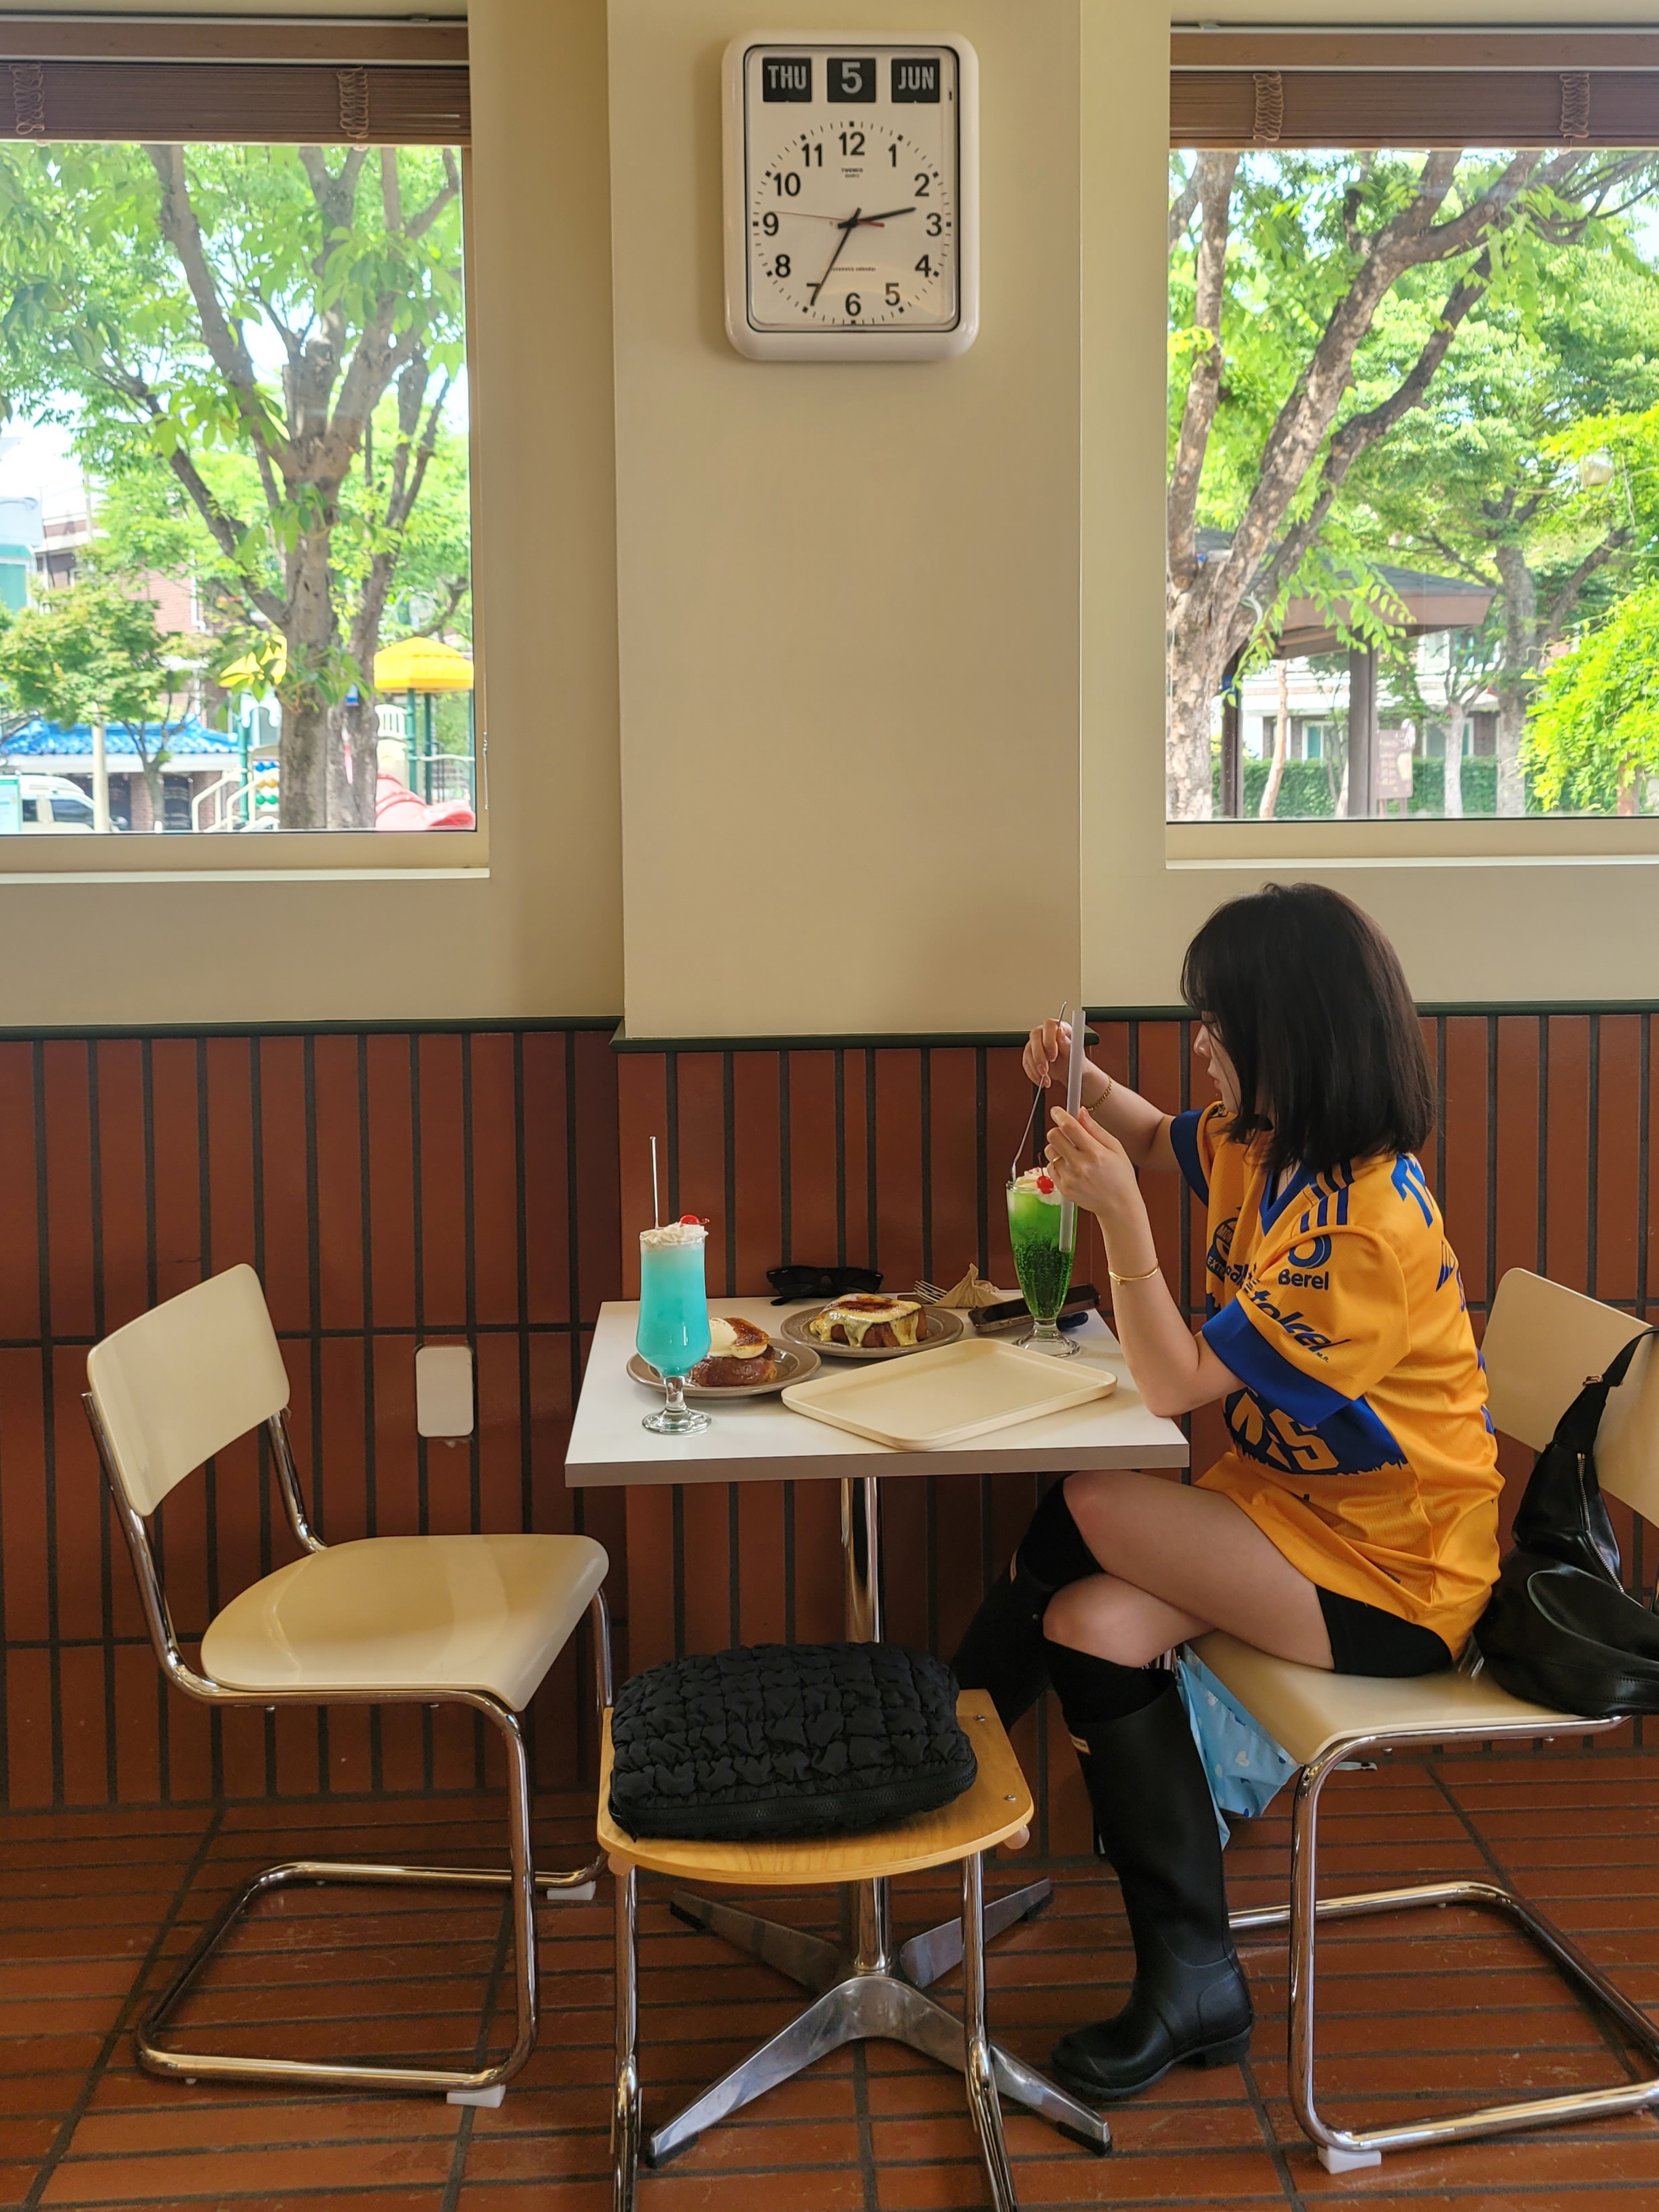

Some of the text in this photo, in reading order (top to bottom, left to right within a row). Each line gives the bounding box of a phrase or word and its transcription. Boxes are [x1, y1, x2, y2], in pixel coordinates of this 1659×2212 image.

[767, 62, 935, 94] THU 5 JUN
[801, 143, 822, 167] 11
[839, 131, 865, 156] 12
[888, 143, 896, 167] 1
[773, 171, 801, 197] 10
[914, 173, 930, 197] 2
[763, 211, 779, 237] 9
[926, 212, 943, 237] 3
[775, 254, 791, 279] 8
[914, 254, 932, 278] 4
[806, 282, 821, 307] 7
[845, 292, 862, 317] 6
[885, 282, 901, 307] 5
[1278, 1268, 1329, 1291] Berel
